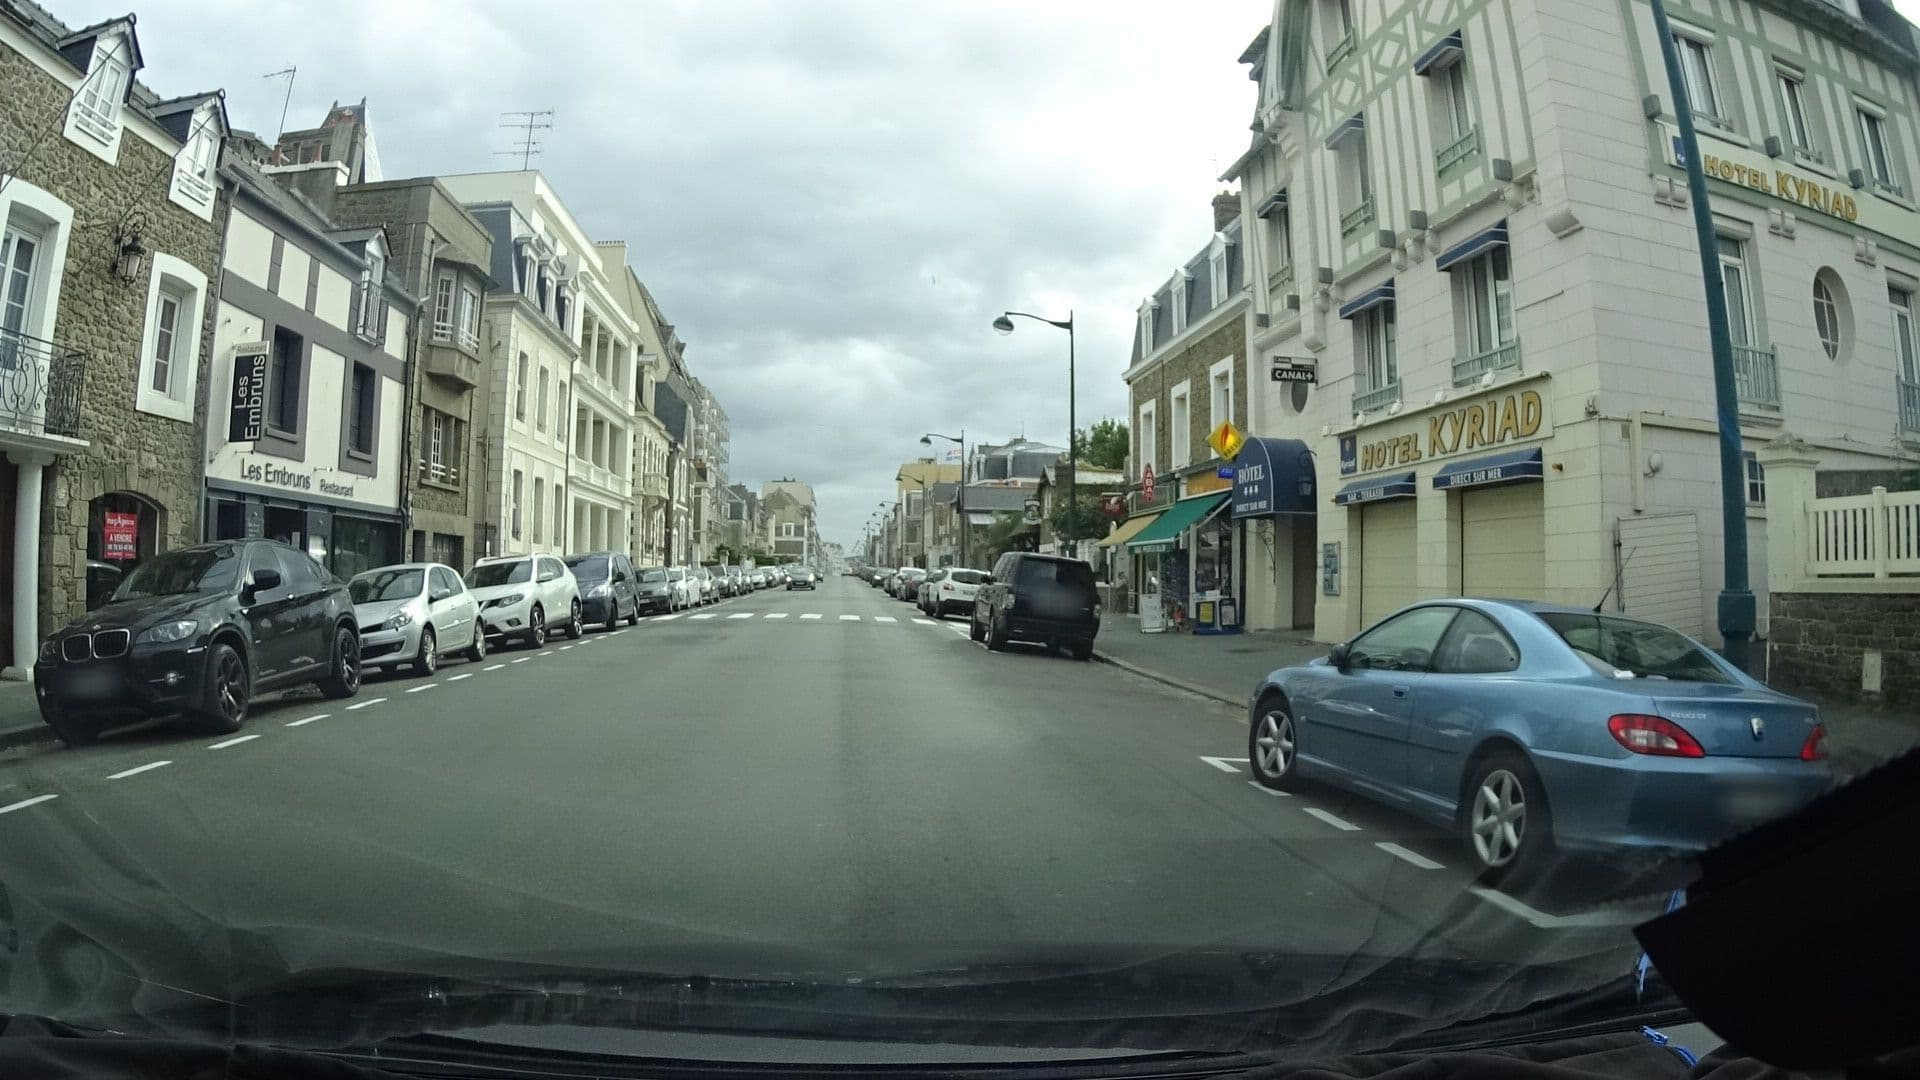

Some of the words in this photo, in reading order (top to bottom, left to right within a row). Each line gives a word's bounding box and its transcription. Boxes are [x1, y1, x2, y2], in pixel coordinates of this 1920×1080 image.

[1704, 154, 1772, 193] HOTEL
[1775, 170, 1858, 221] KYRIAD
[1275, 370, 1314, 380] CANAL+
[234, 376, 249, 409] Les
[244, 355, 265, 440] Embruns
[1361, 432, 1422, 472] HOTEL
[1428, 390, 1543, 457] KYRIAD
[241, 458, 262, 480] Les
[265, 462, 311, 490] Embruns
[319, 478, 354, 497] Restaurant
[1238, 463, 1265, 485] HÔTEL
[1450, 472, 1471, 485] DIRECT
[1473, 470, 1486, 482] SUR
[1487, 468, 1502, 480] MER
